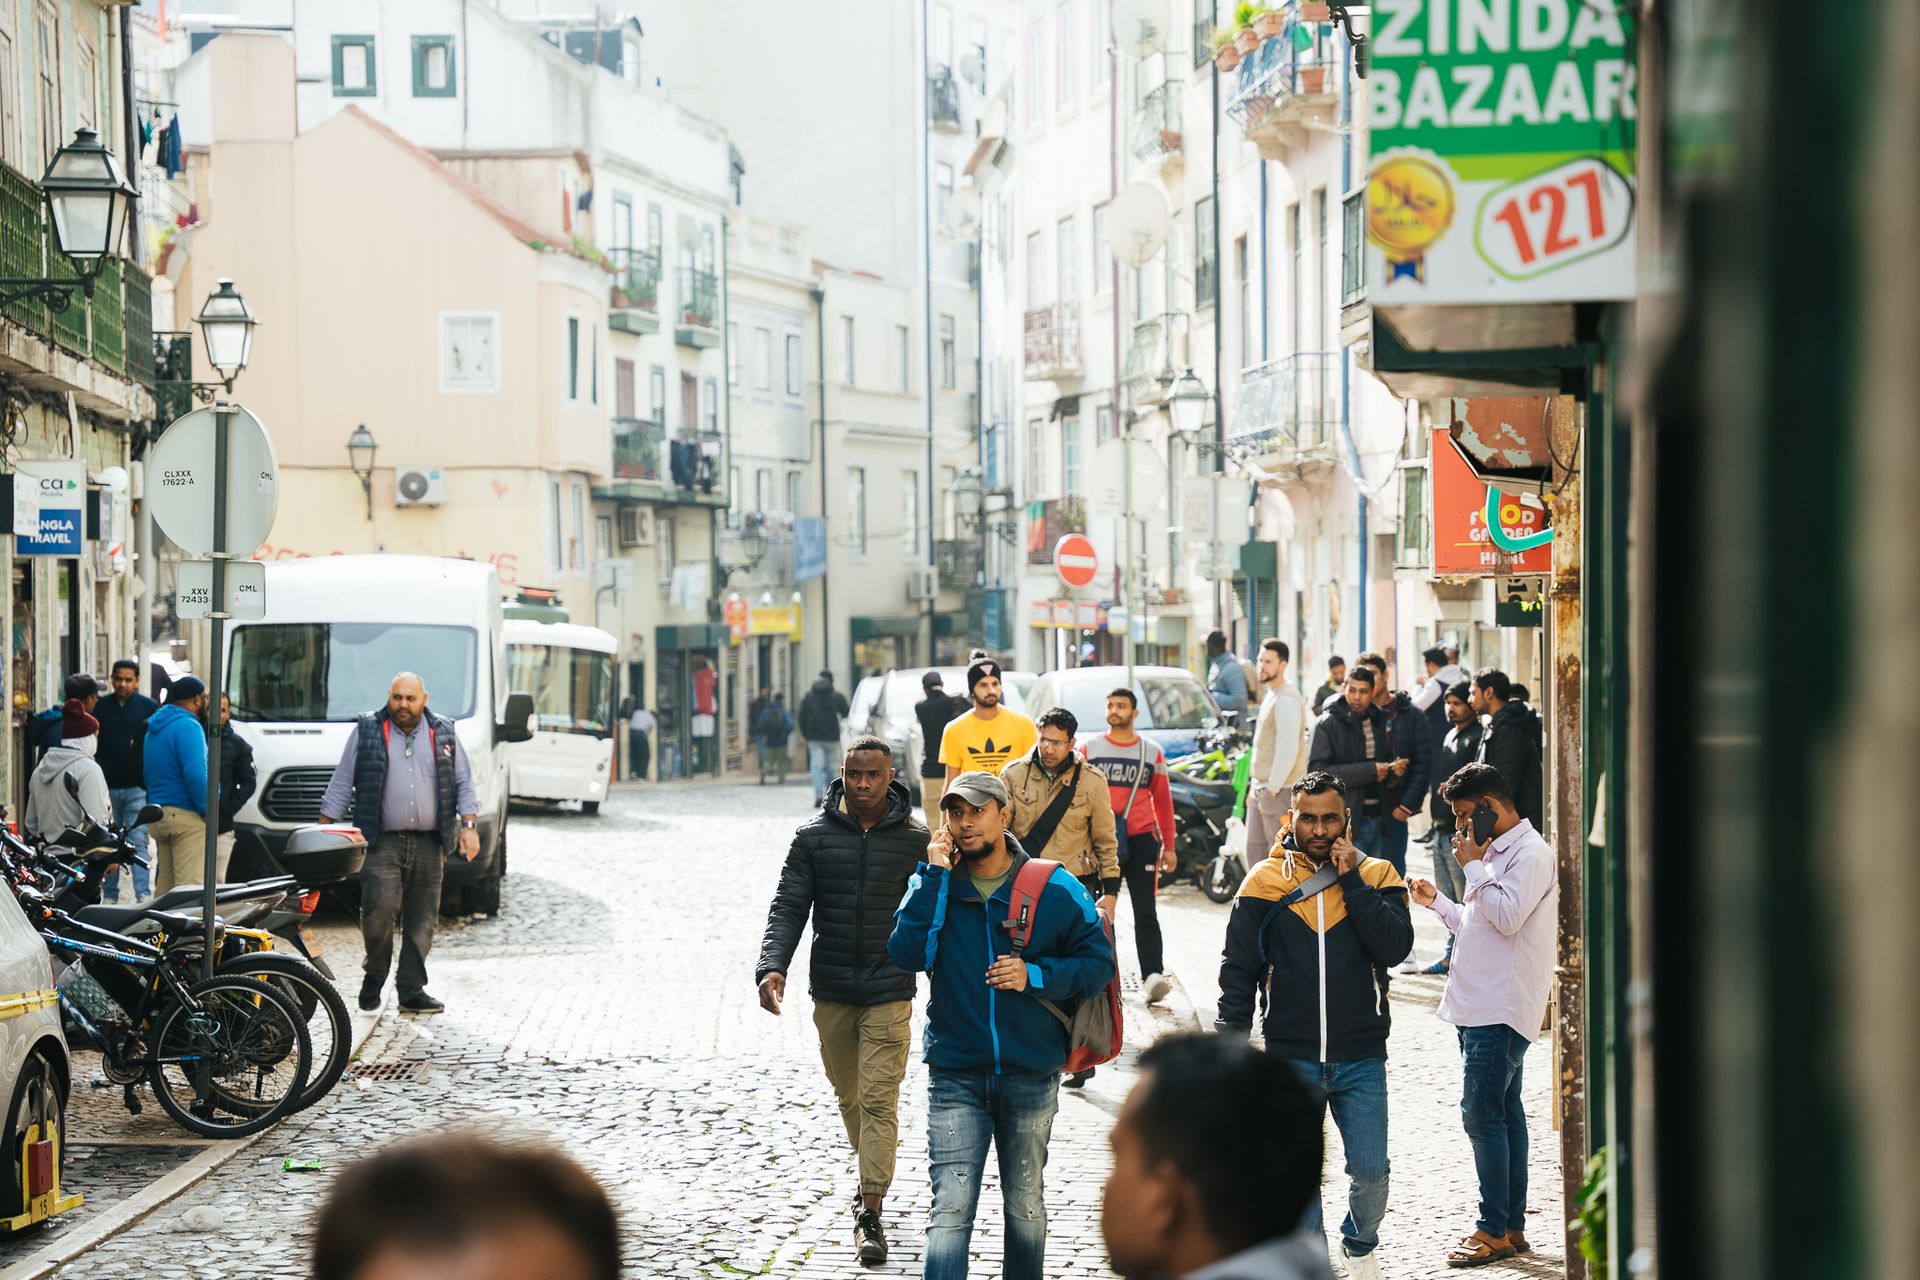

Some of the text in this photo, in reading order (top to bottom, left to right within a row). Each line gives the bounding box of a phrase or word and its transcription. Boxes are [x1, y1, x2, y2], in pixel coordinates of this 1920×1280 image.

[1371, 0, 1626, 56] ZINDA
[1369, 59, 1637, 129] BAZAAR
[1493, 168, 1606, 265] 127
[164, 470, 191, 478] CLXXX
[261, 472, 273, 480] CML
[162, 478, 195, 486] 17622-A
[38, 519, 74, 531] NGLA
[1469, 527, 1534, 542] GADEN
[239, 584, 257, 592] CML
[40, 1199, 48, 1216] 15
